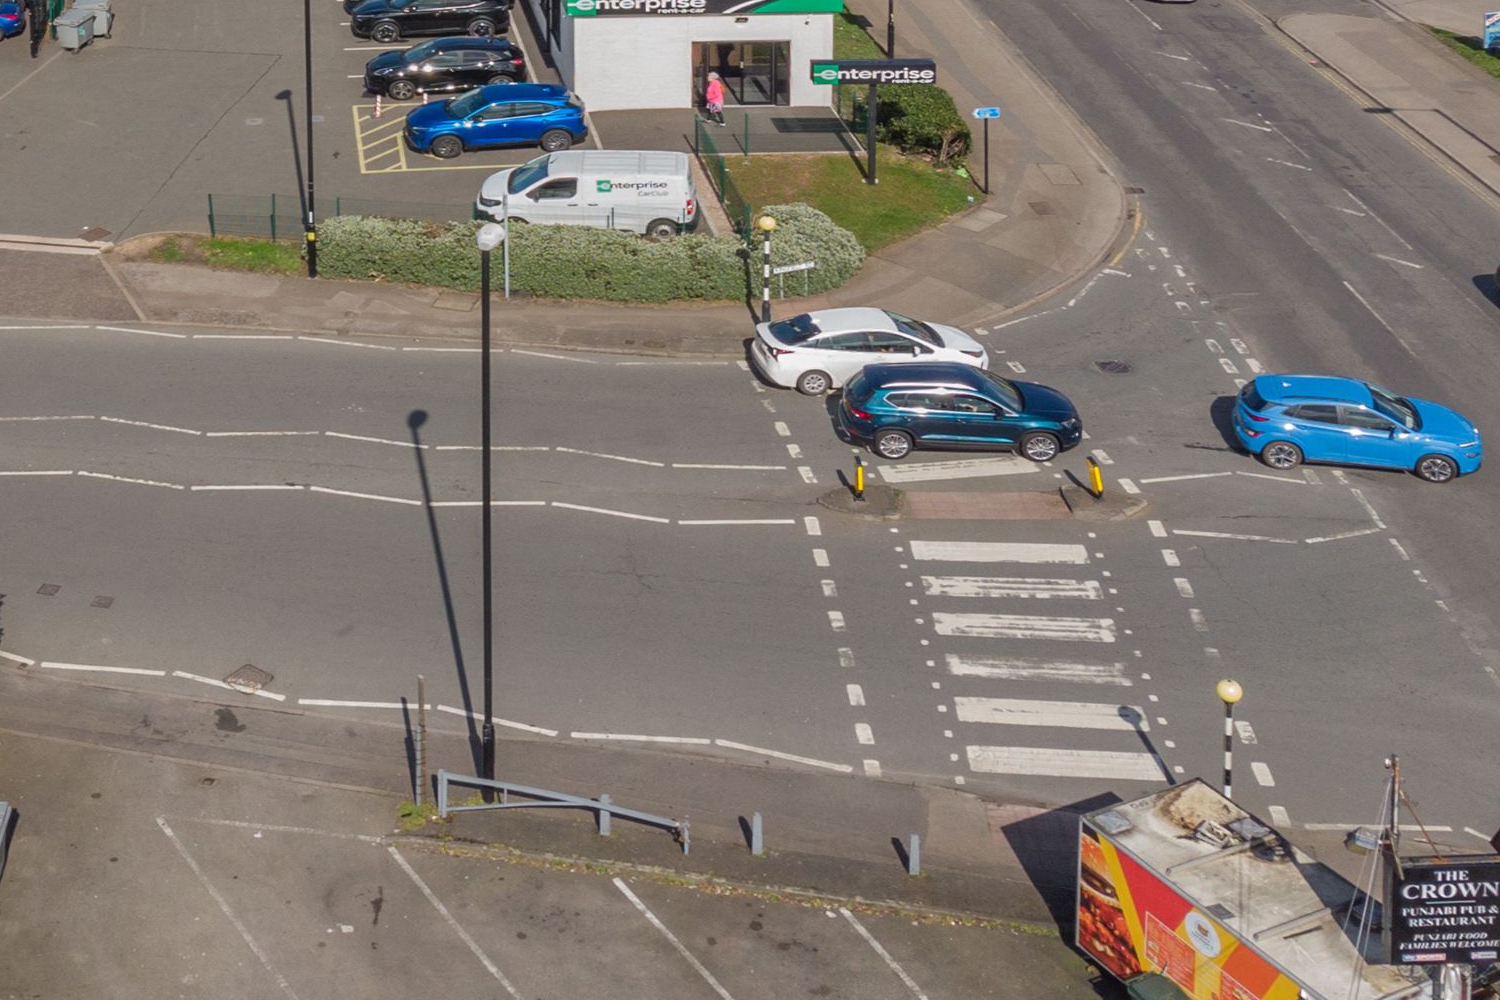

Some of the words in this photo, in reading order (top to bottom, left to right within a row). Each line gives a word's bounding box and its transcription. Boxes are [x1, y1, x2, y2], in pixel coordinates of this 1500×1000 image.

[814, 67, 935, 82] enterprise
[599, 181, 668, 190] enterprise
[1434, 870, 1469, 882] THE
[1402, 882, 1499, 900] CROWN
[1402, 906, 1457, 917] PUNJABI
[1460, 905, 1486, 915] PUB
[1488, 904, 1499, 914] &
[1408, 916, 1496, 928] RESTAURANT
[1413, 932, 1457, 941] PUNJABI
[1459, 932, 1488, 940] FOOD
[1400, 941, 1448, 950] FAMILIES
[1449, 940, 1500, 948] WELCOME
